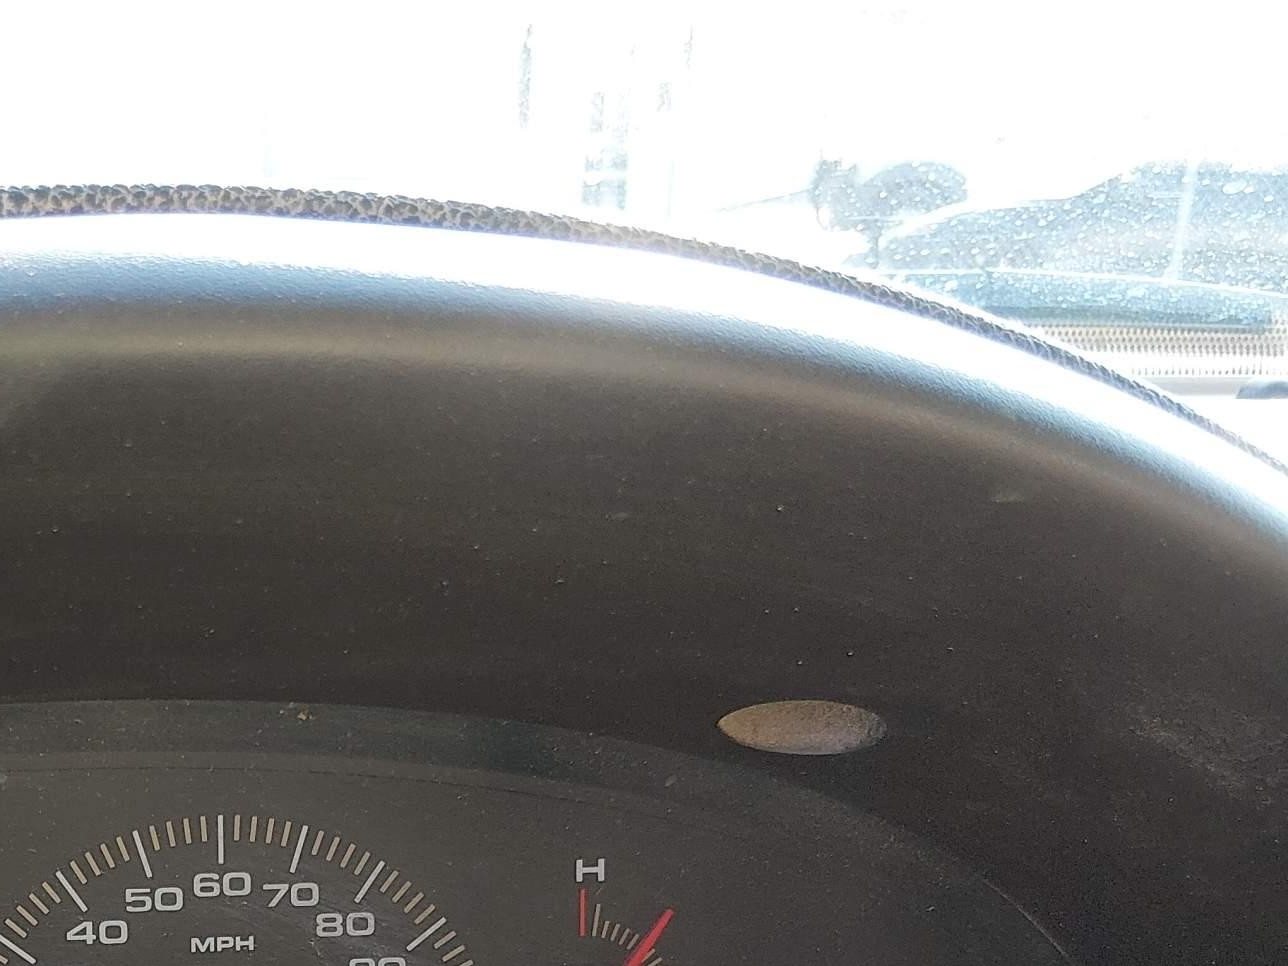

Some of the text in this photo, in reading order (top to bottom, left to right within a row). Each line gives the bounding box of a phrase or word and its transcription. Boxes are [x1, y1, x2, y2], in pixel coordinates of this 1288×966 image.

[576, 858, 605, 882] H
[193, 872, 251, 897] 60
[262, 882, 320, 908] 70
[124, 887, 184, 913] 50
[66, 920, 128, 945] 40
[315, 913, 375, 938] 80
[190, 935, 255, 953] MPH
